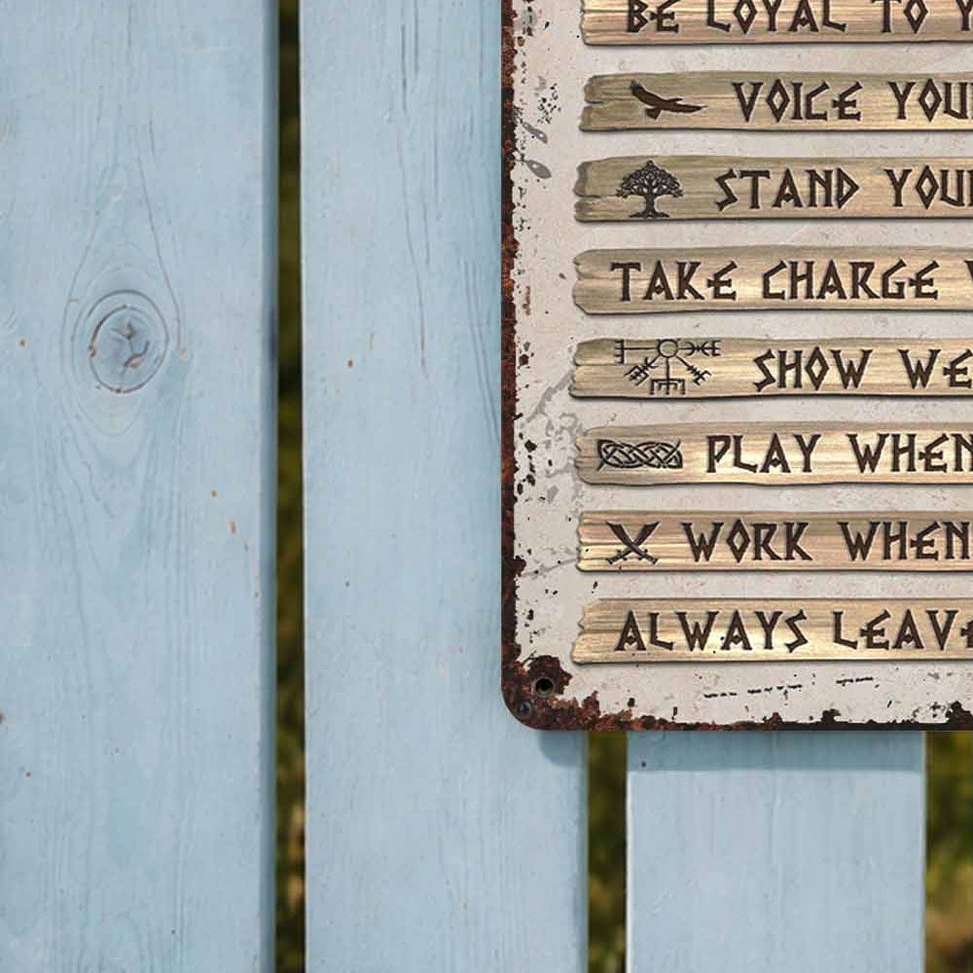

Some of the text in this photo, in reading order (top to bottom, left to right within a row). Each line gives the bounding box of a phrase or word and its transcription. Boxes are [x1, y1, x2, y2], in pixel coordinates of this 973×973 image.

[732, 79, 863, 122] VOICE
[715, 165, 860, 210] STAND
[611, 256, 737, 301] TAKE
[762, 256, 939, 301] CHARGE
[753, 346, 873, 390] SHOW
[706, 430, 822, 474] PLAY
[683, 517, 813, 562] WORK
[837, 517, 971, 562] WHEN
[614, 605, 809, 651] ALWAYS
